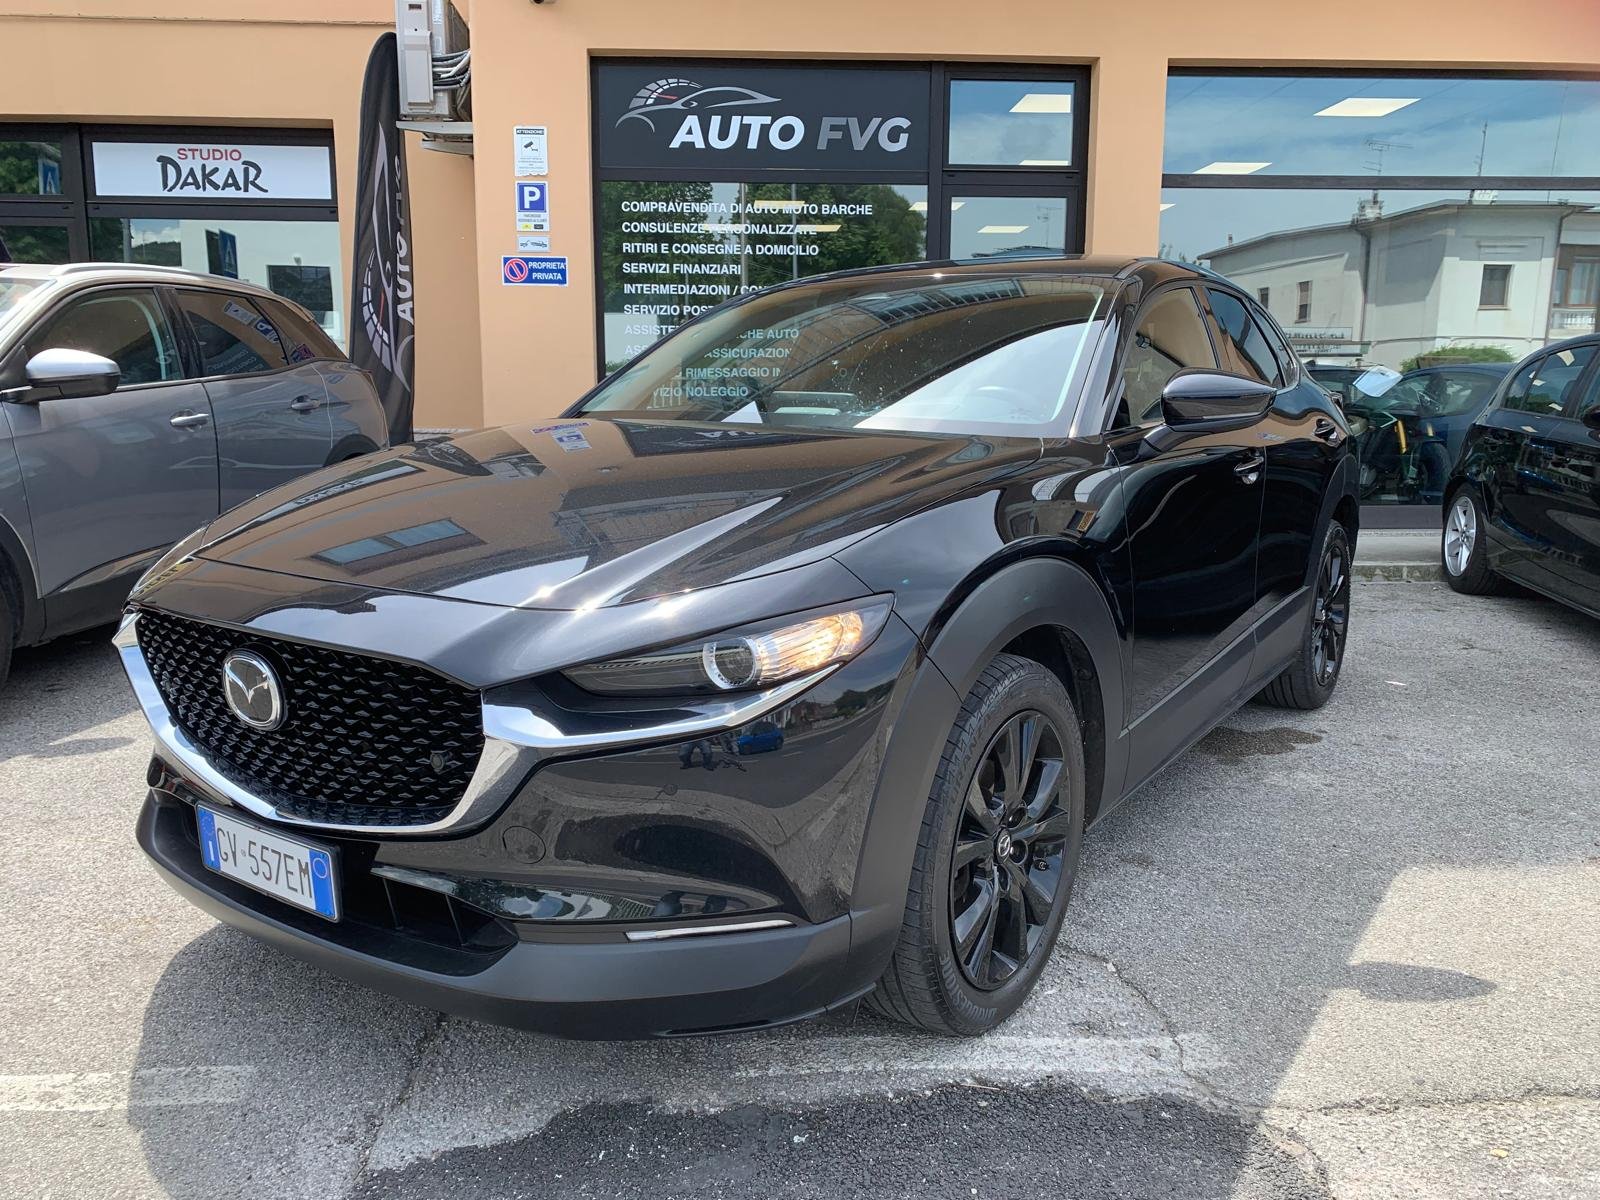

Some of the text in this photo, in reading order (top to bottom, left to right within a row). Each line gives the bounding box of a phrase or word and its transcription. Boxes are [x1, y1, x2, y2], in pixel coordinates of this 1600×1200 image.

[669, 115, 911, 152] AUTO FVG
[177, 148, 242, 161] STUDIO
[156, 155, 269, 193] DAKAR
[524, 186, 541, 209] P
[621, 201, 872, 215] COMPRAVENDITA DI AUTO MOTO BARCHE
[621, 222, 705, 233] CONSULENZE
[622, 243, 819, 256] RITIRI E CONSEGNE A DOMICILIO
[622, 263, 741, 275] SERVIZI FINANZIARI
[396, 231, 415, 327] AUTO
[532, 272, 562, 280] PRIVATA
[623, 284, 731, 295] INTERMEDIAZIONI
[623, 304, 680, 316] SERVIZIO
[767, 328, 799, 339] AUTO
[685, 367, 769, 378] RIMESSAGGIO
[686, 386, 749, 397] NOLEGGIO
